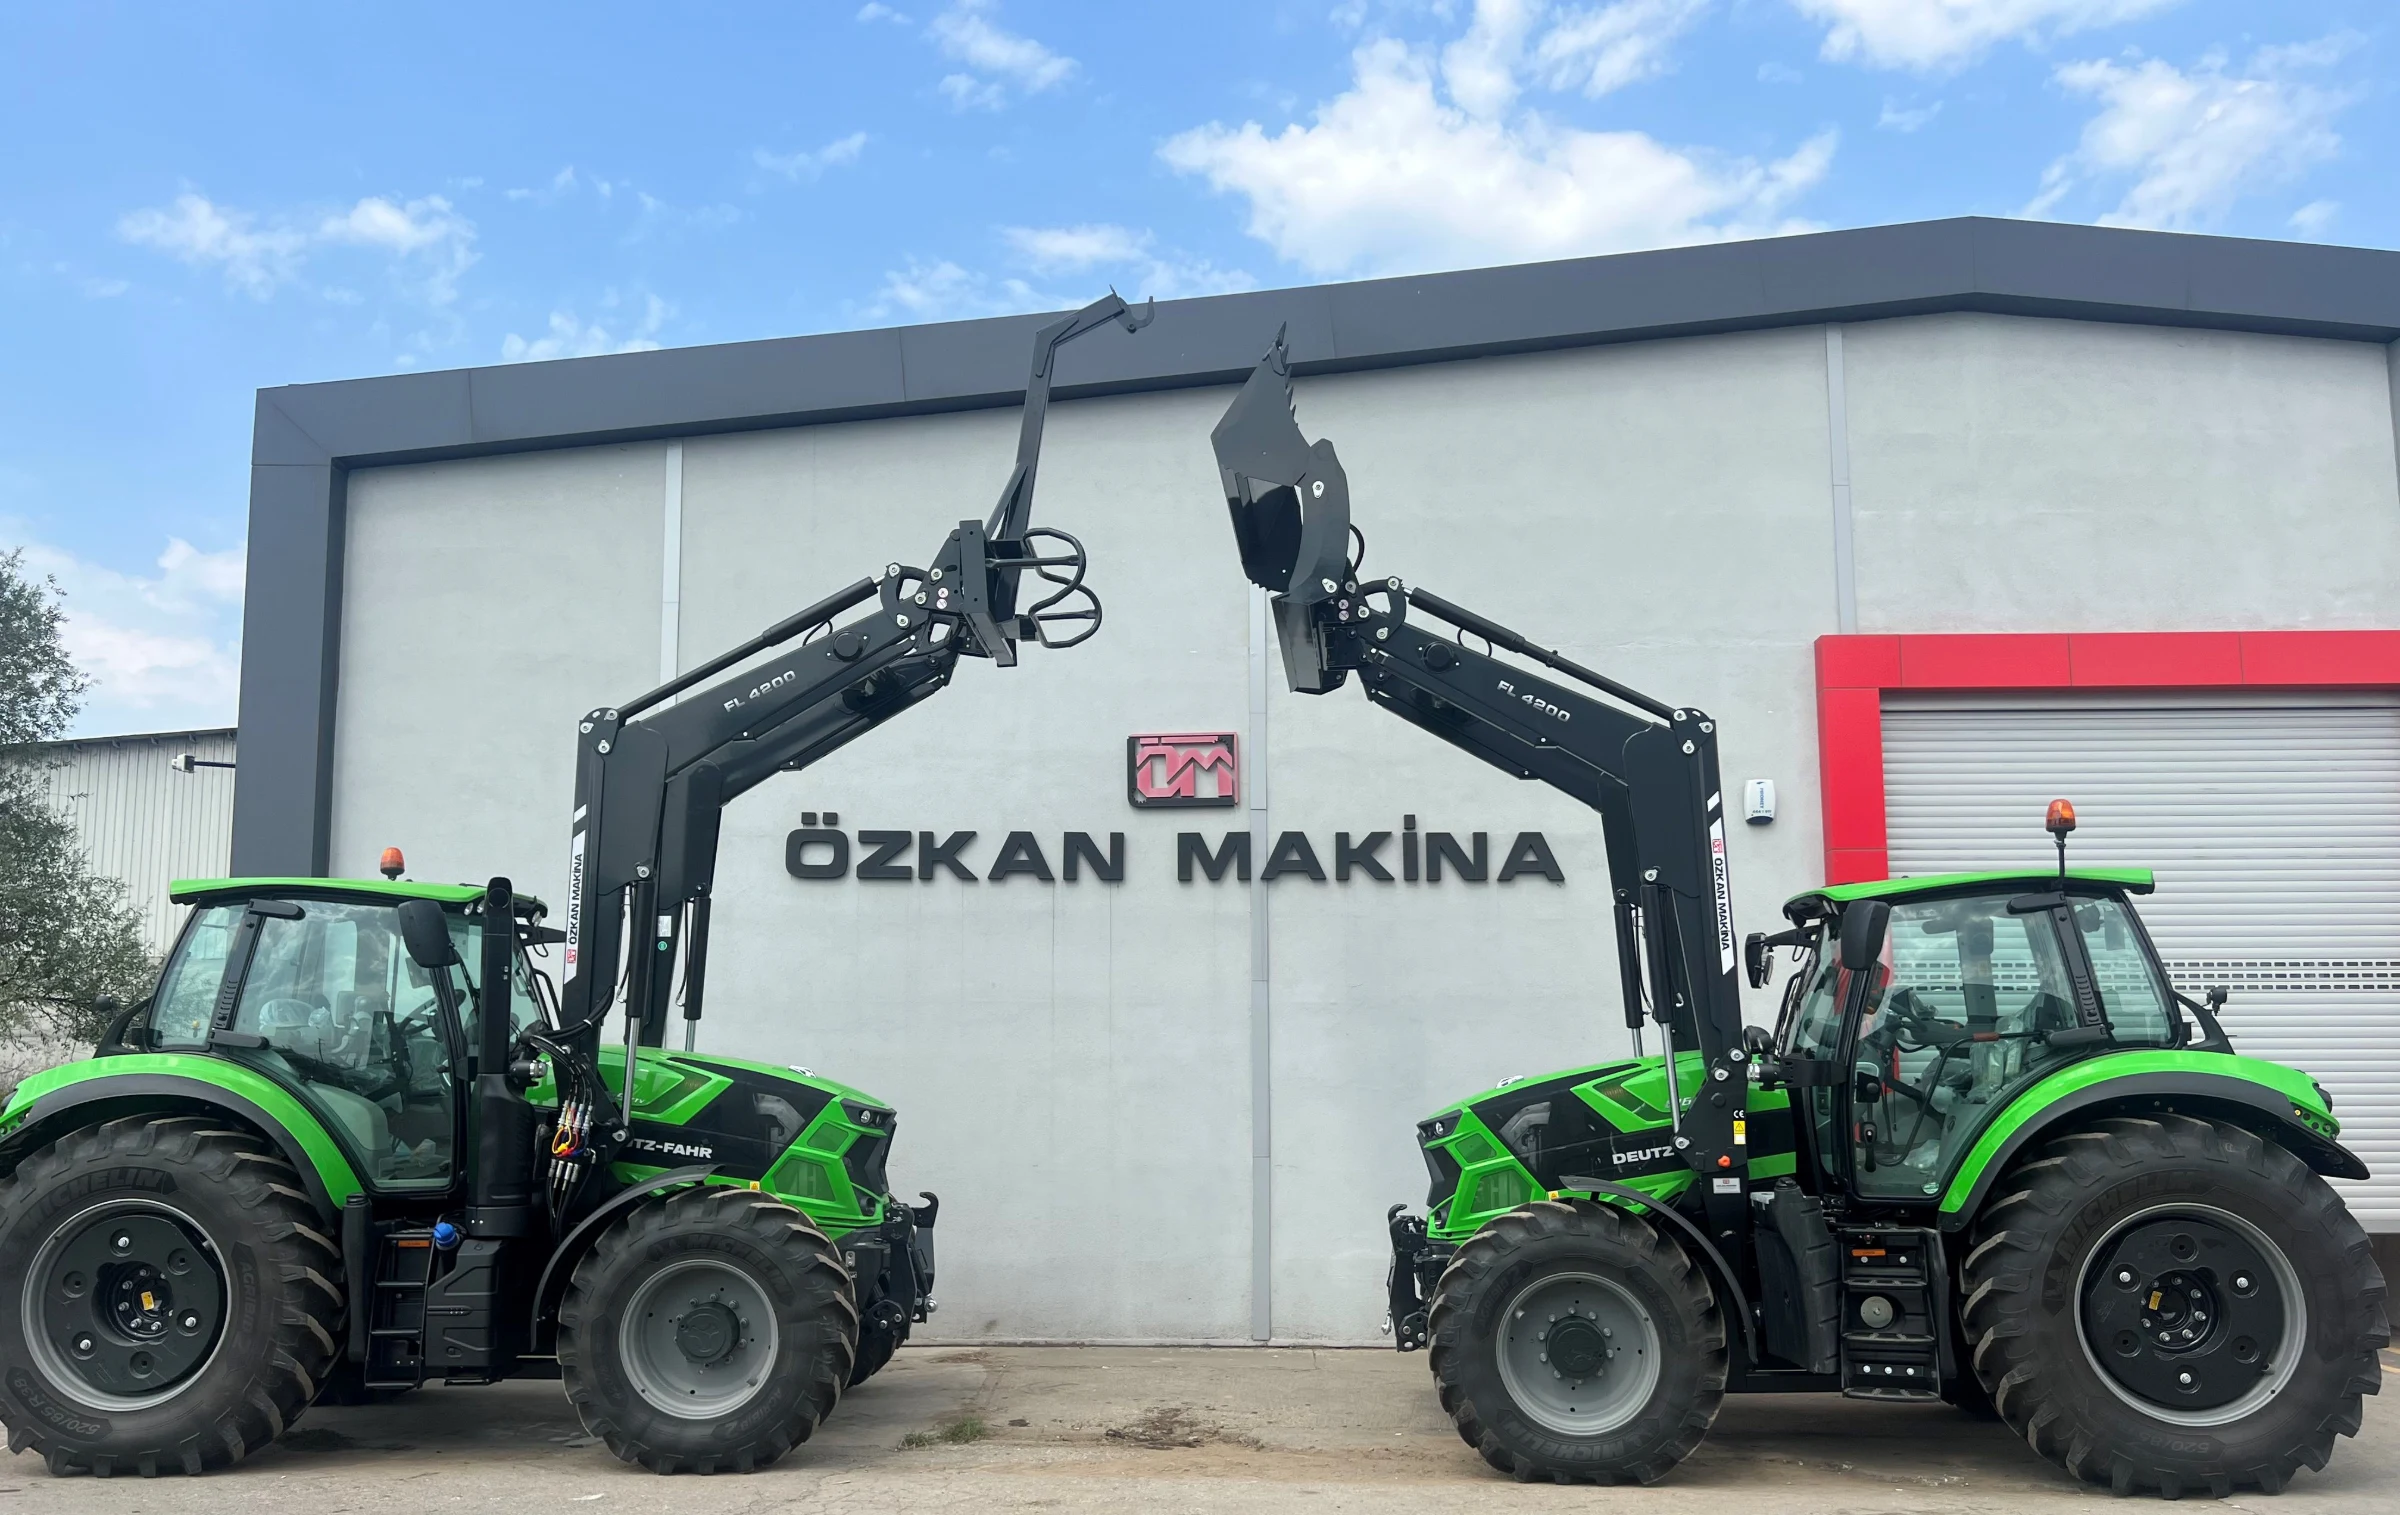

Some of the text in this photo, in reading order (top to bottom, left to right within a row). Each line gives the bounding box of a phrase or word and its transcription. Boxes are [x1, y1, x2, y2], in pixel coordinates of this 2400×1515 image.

[723, 670, 796, 713] FL 4200
[1497, 680, 1571, 722] FL 4200
[785, 812, 1565, 882] ÖZKAN MAKİNA
[571, 853, 583, 901] MAKİNA
[1714, 857, 1726, 900] ÖZKAN
[568, 903, 580, 945] ÖZKAN
[1717, 902, 1730, 951] MAKİNA
[1612, 1146, 1675, 1165] DEUTZ
